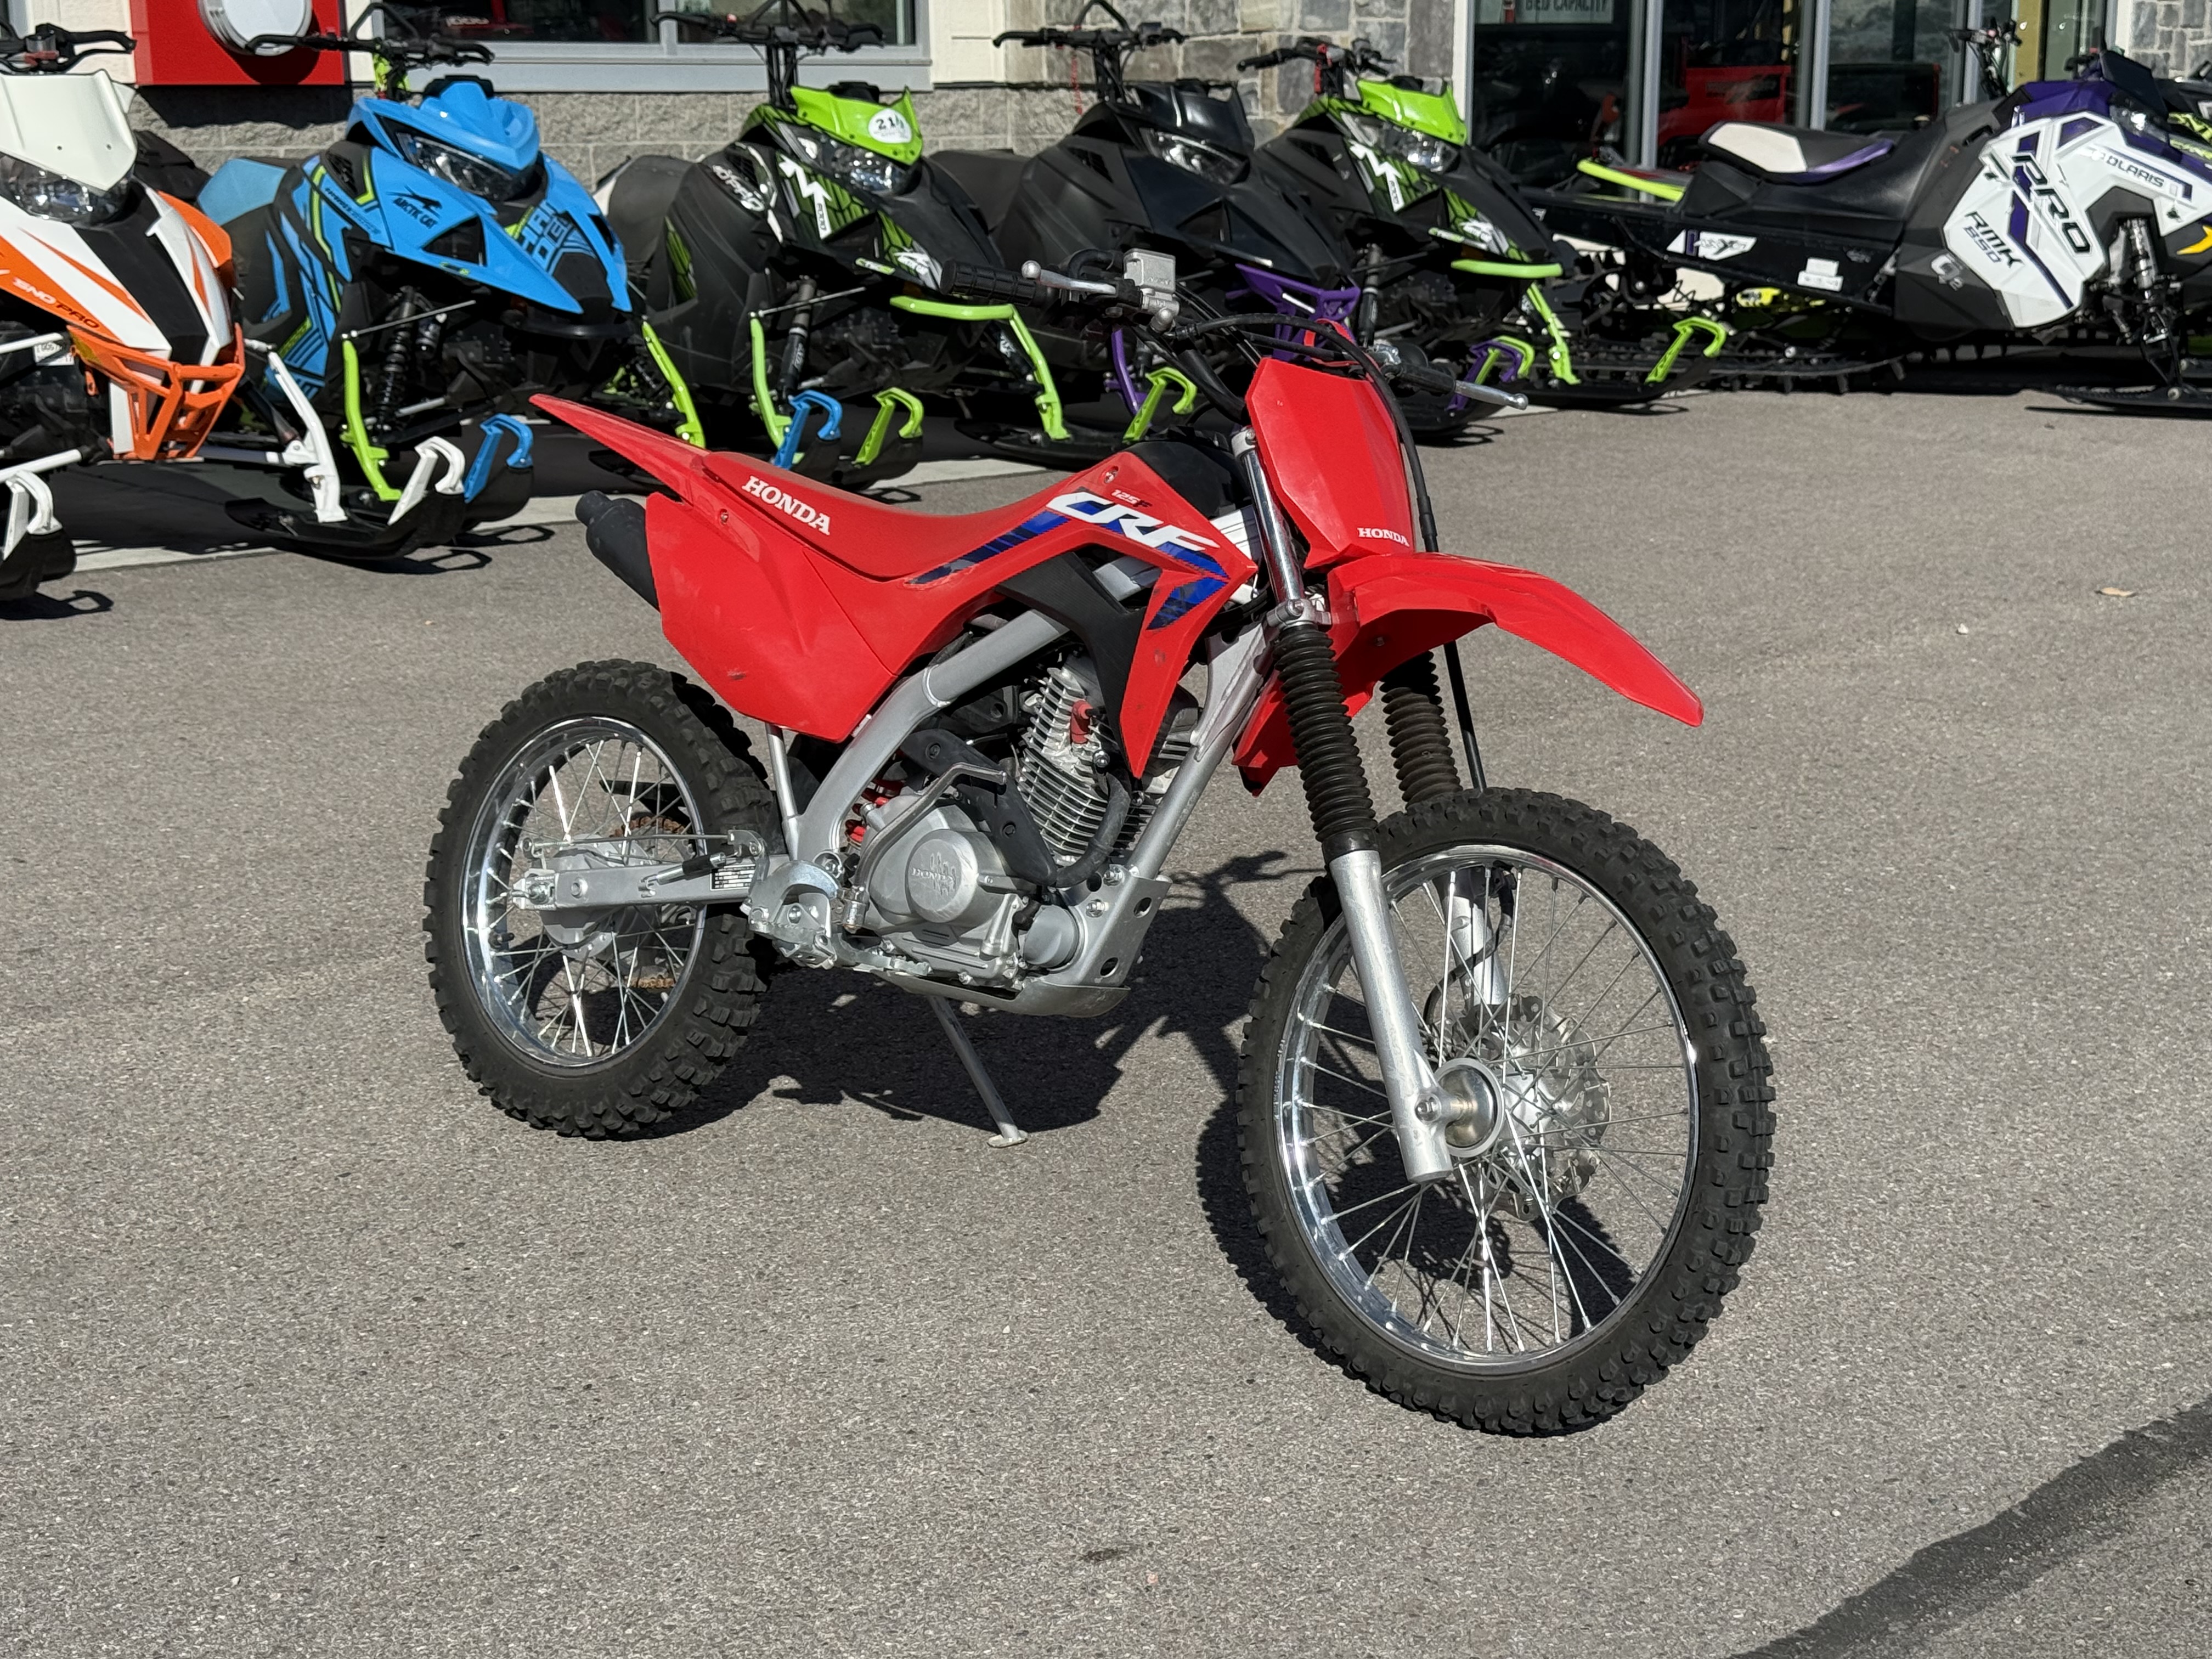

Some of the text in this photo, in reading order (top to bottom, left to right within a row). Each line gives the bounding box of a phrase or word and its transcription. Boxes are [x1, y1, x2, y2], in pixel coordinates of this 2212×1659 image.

[393, 197, 438, 229] ARCTIC CAT
[2011, 154, 2091, 253] PRO
[1965, 211, 2024, 268] RMK
[56, 300, 100, 329] PRO
[742, 475, 830, 535] HONDA
[1046, 492, 1220, 551] CRF
[1357, 528, 1410, 547] HONDA
[911, 867, 953, 882] HONDA
